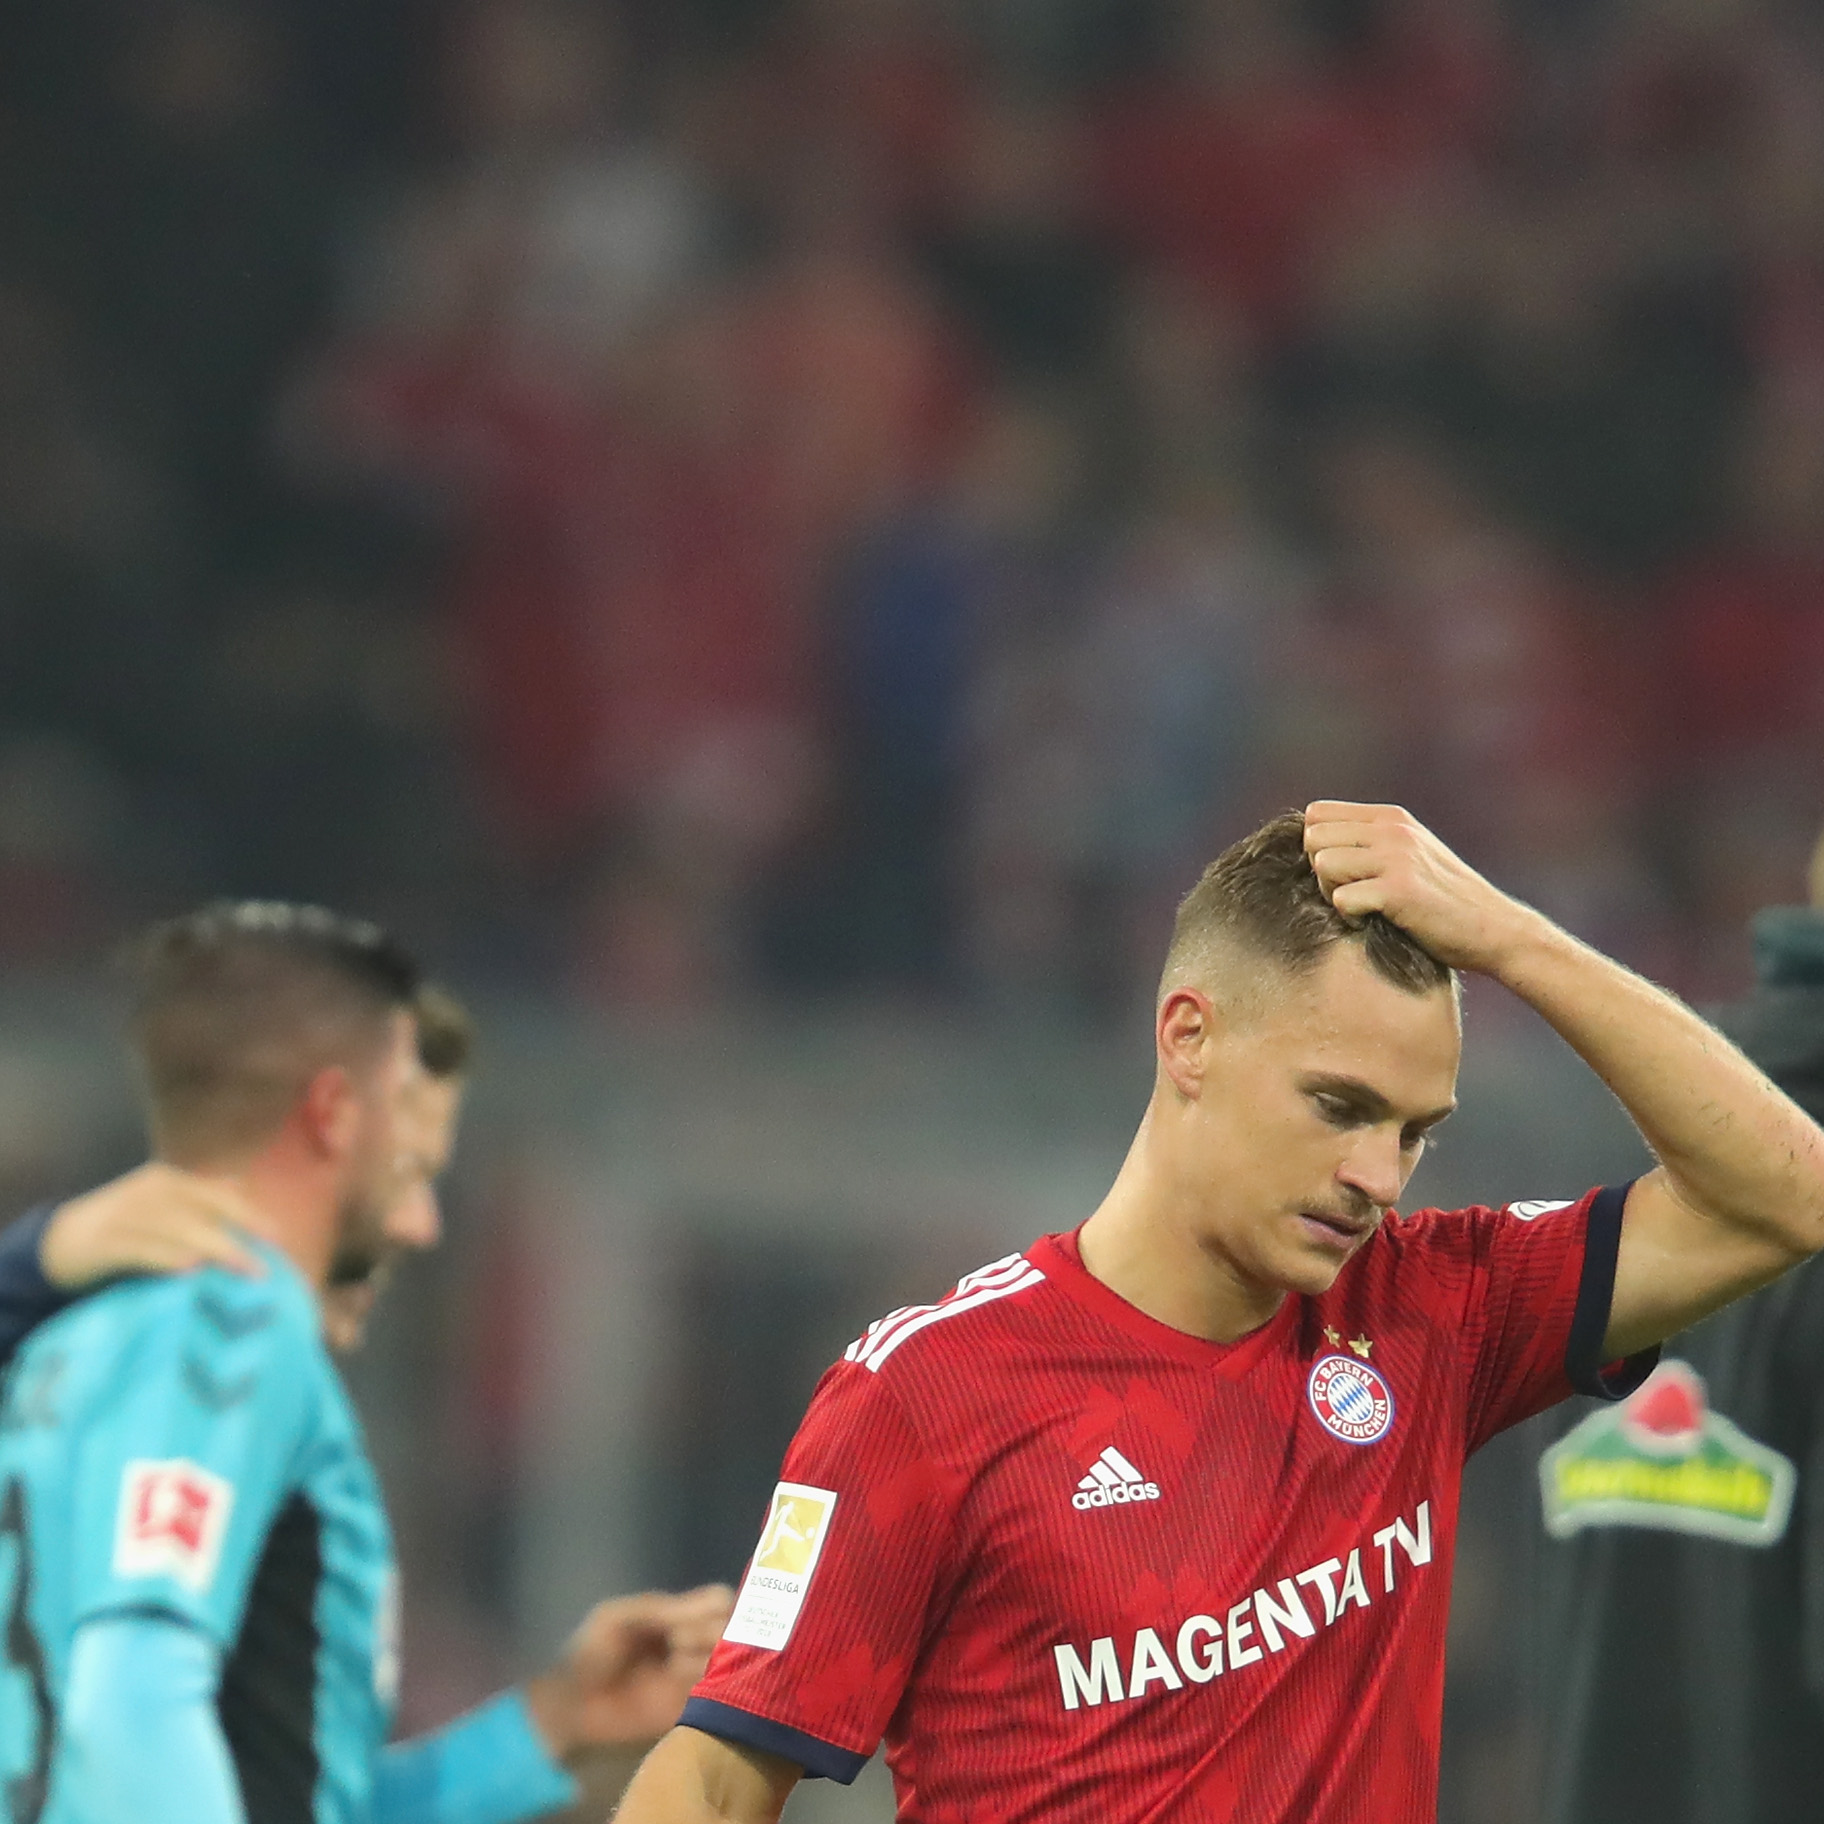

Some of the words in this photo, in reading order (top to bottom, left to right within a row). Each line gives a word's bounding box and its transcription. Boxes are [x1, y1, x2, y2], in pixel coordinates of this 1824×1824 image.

[1319, 1360, 1374, 1387] BAYERN
[1314, 1380, 1327, 1401] FC
[1071, 1480, 1161, 1510] adidas
[750, 1575, 800, 1595] BUNDESLIGA
[1053, 1547, 1372, 1711] MAGENTA
[1373, 1499, 1433, 1594] TV
